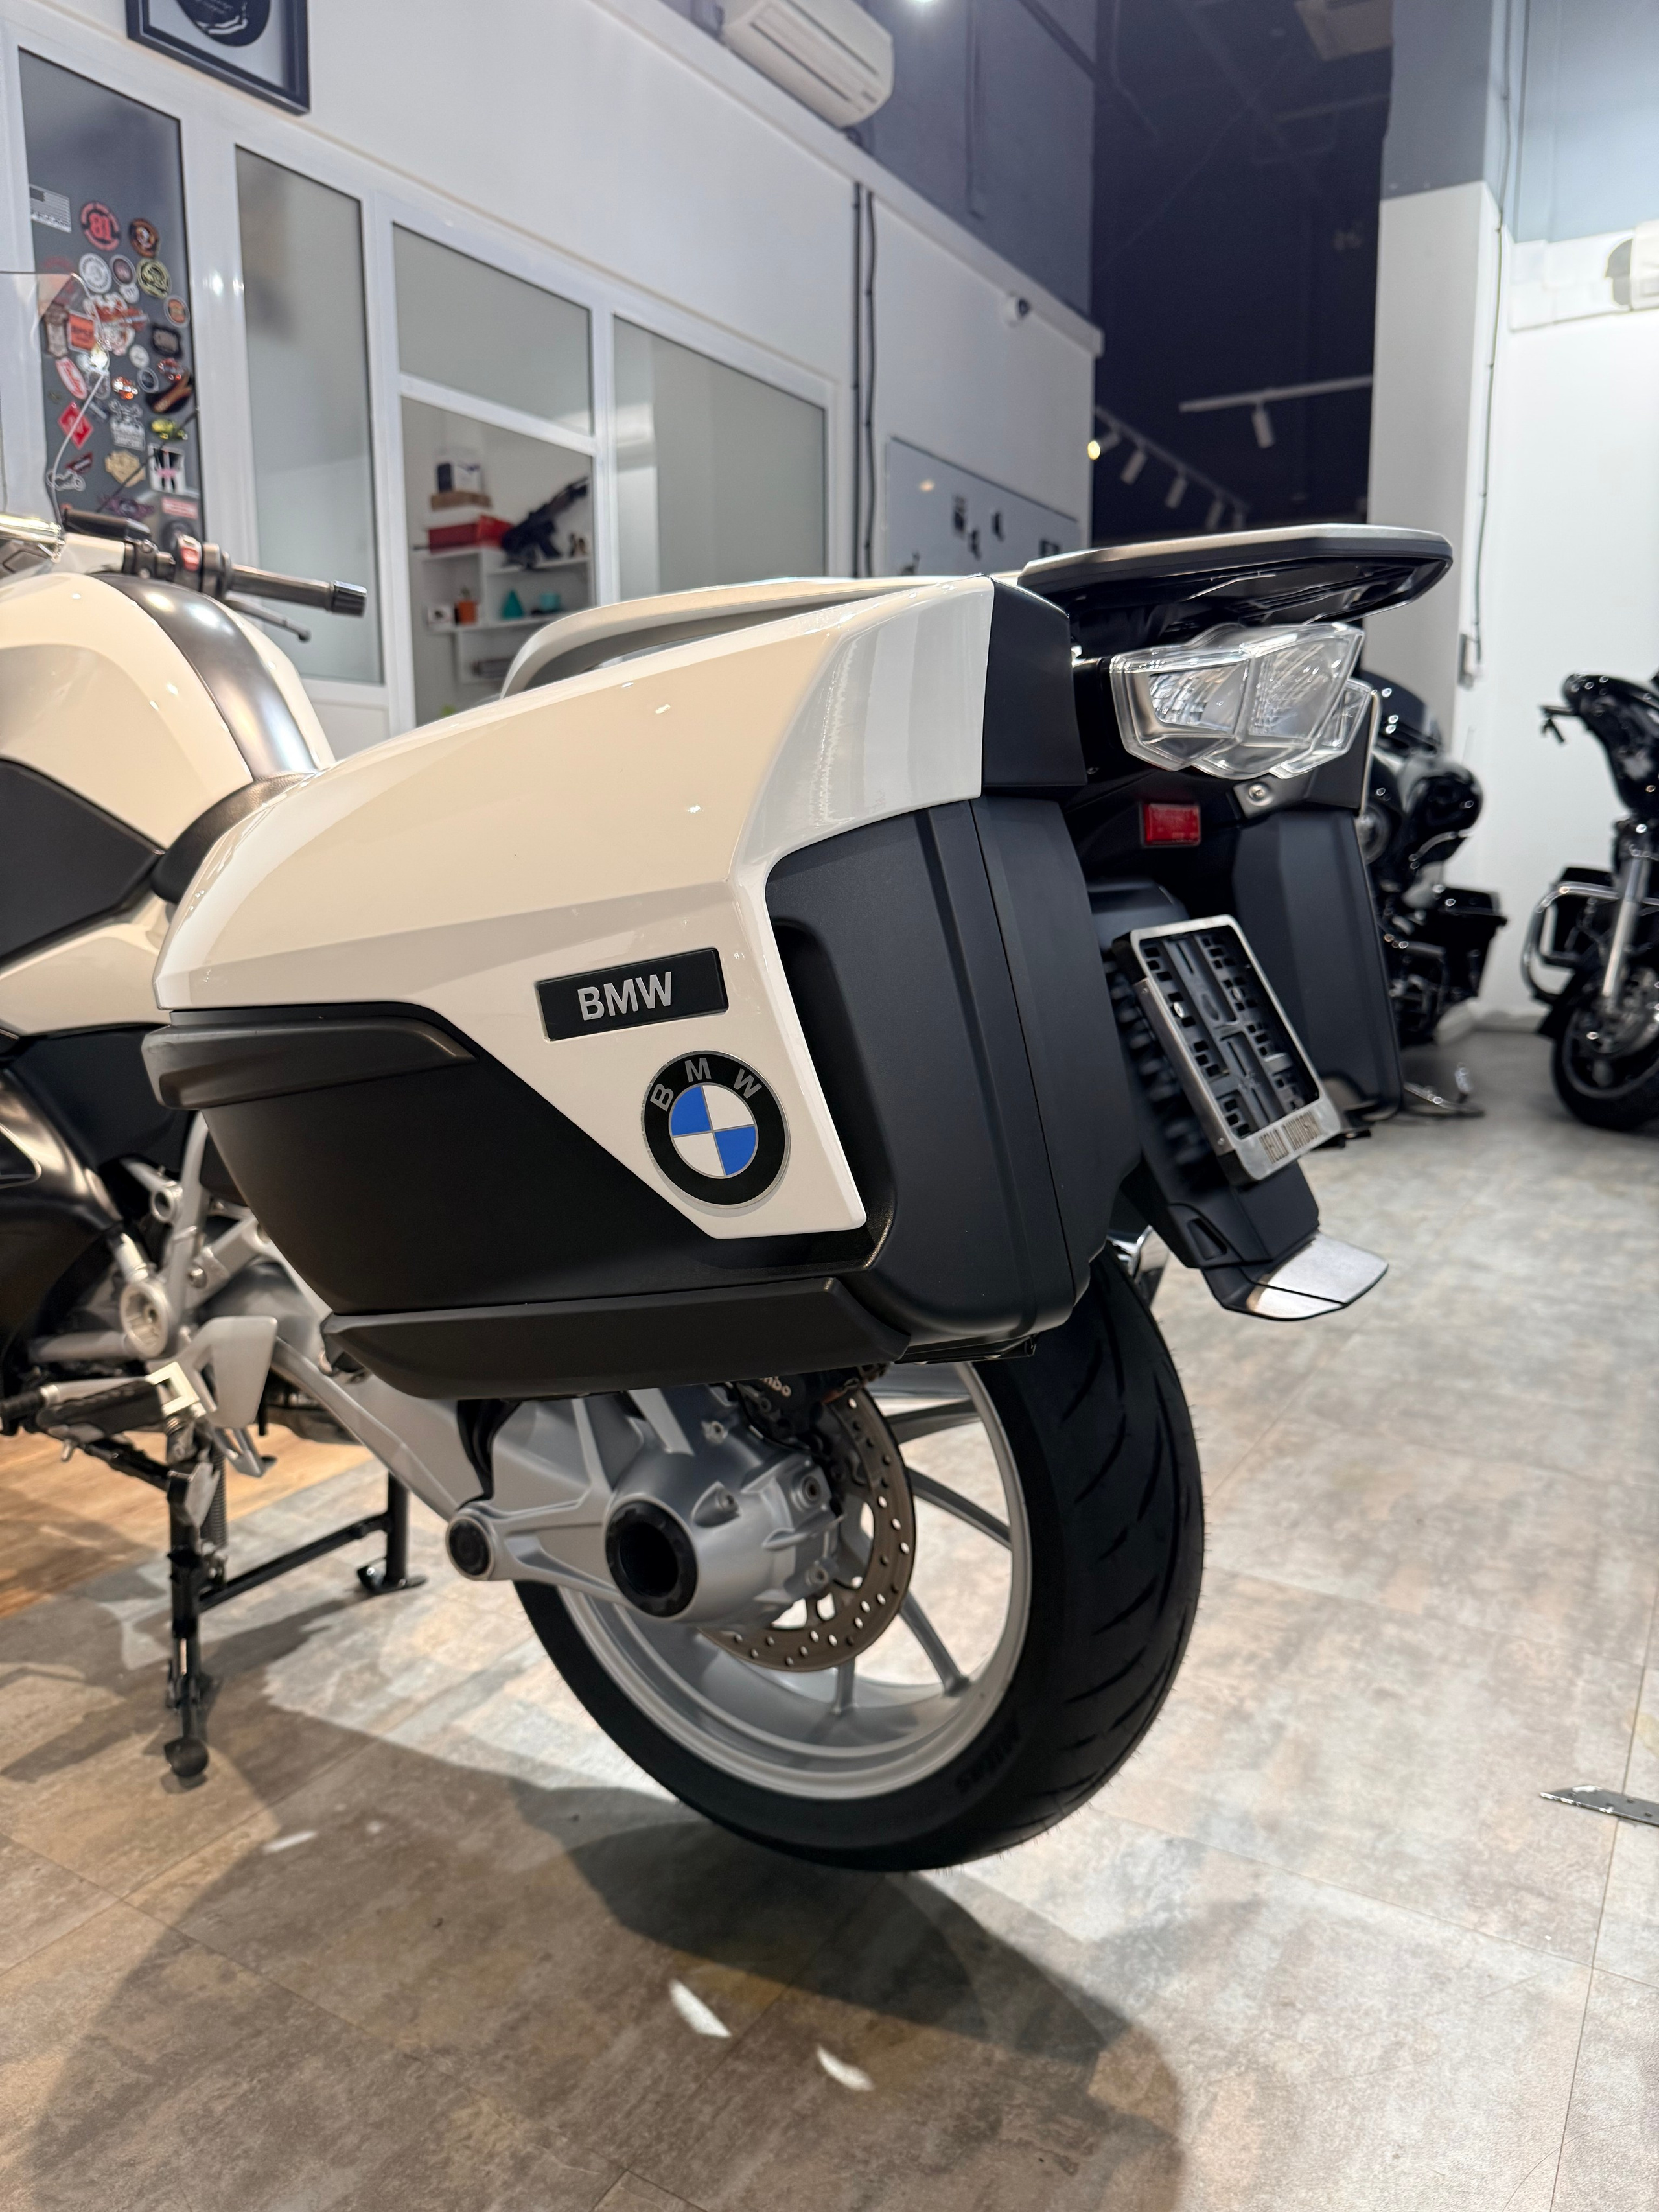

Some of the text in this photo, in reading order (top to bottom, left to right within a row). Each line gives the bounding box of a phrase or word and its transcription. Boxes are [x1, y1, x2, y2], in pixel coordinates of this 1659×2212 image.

[89, 212, 112, 240] 81
[577, 972, 672, 1021] BMW
[650, 1058, 762, 1112] BMW
